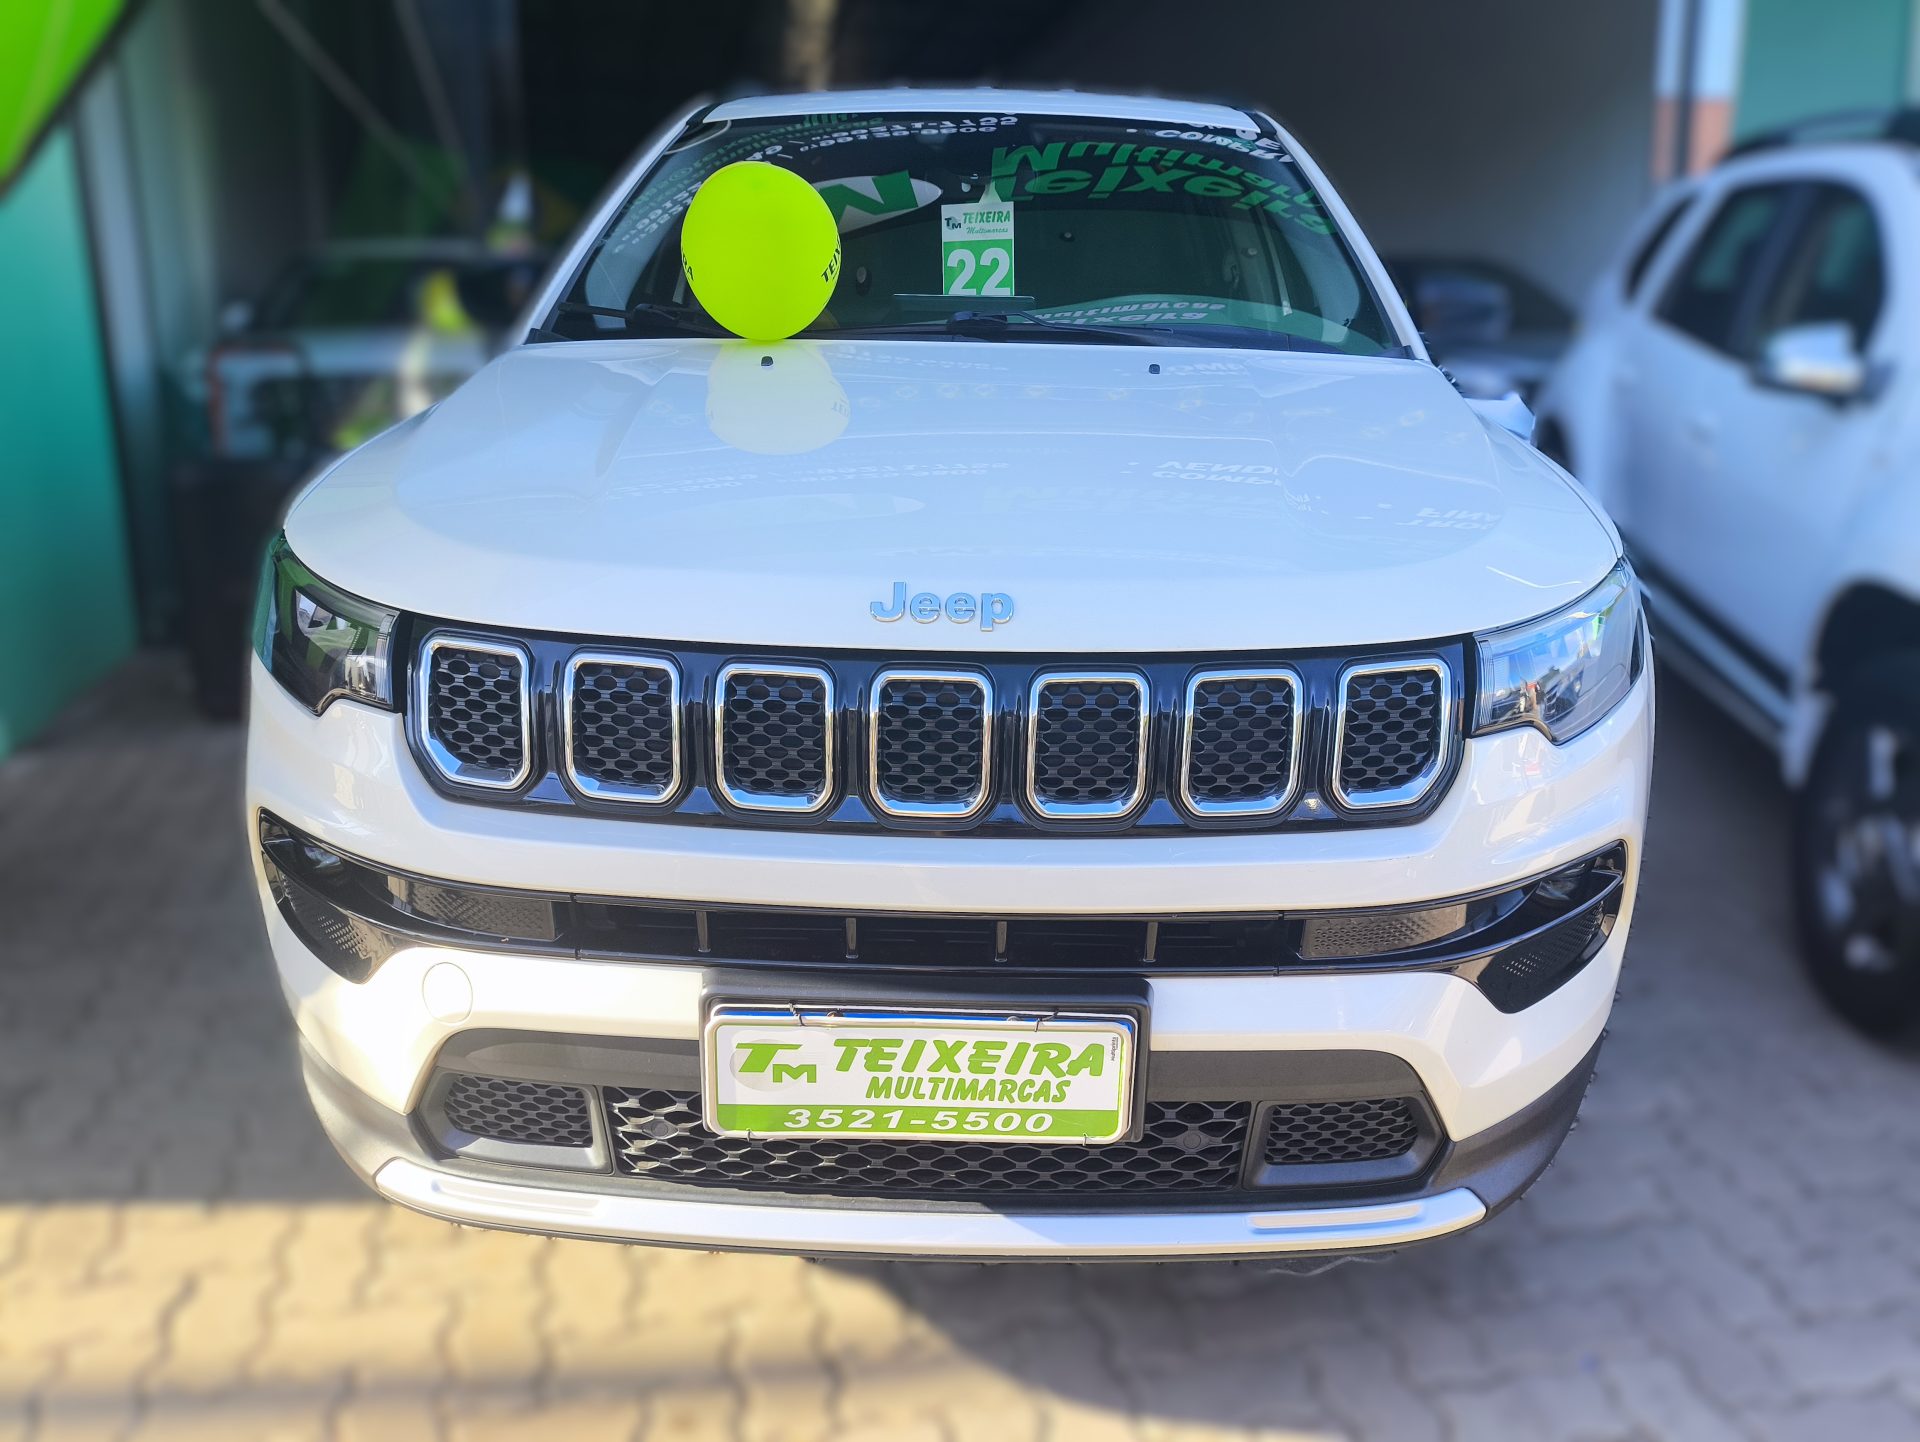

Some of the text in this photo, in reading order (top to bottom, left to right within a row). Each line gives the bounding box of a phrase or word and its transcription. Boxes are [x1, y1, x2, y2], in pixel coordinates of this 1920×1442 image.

[962, 209, 1011, 225] TEIXEIRA
[946, 247, 1011, 296] 22
[869, 580, 1015, 632] Jeep
[832, 1038, 1106, 1078] TEIXEIRA
[864, 1075, 1072, 1104] MULTIMARCAS
[783, 1108, 1055, 1133] 3521-5500
